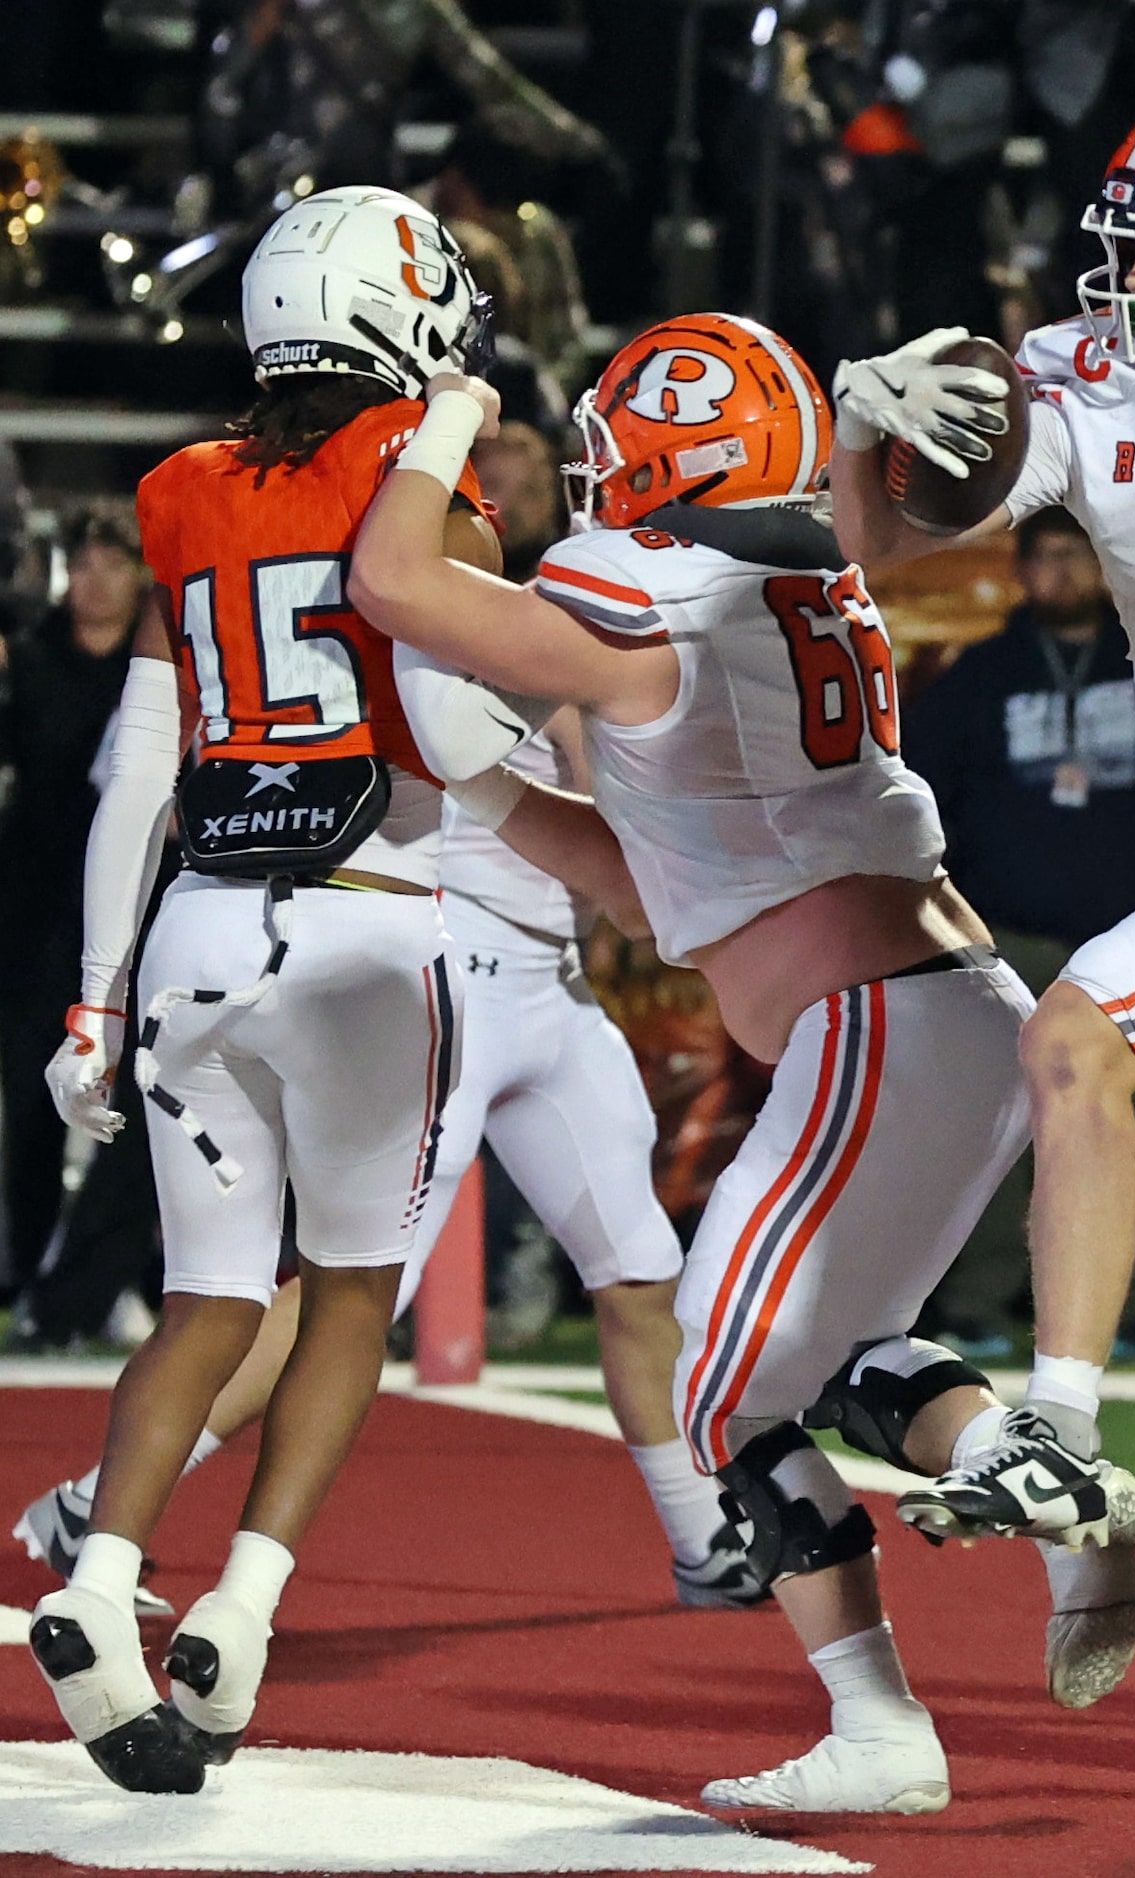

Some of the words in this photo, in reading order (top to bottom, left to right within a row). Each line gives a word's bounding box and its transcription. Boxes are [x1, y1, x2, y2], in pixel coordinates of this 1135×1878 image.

[261, 341, 321, 365] schutt
[626, 346, 737, 426] R
[181, 552, 368, 745] 15
[764, 565, 900, 770] 66
[199, 807, 336, 840] XENITH
